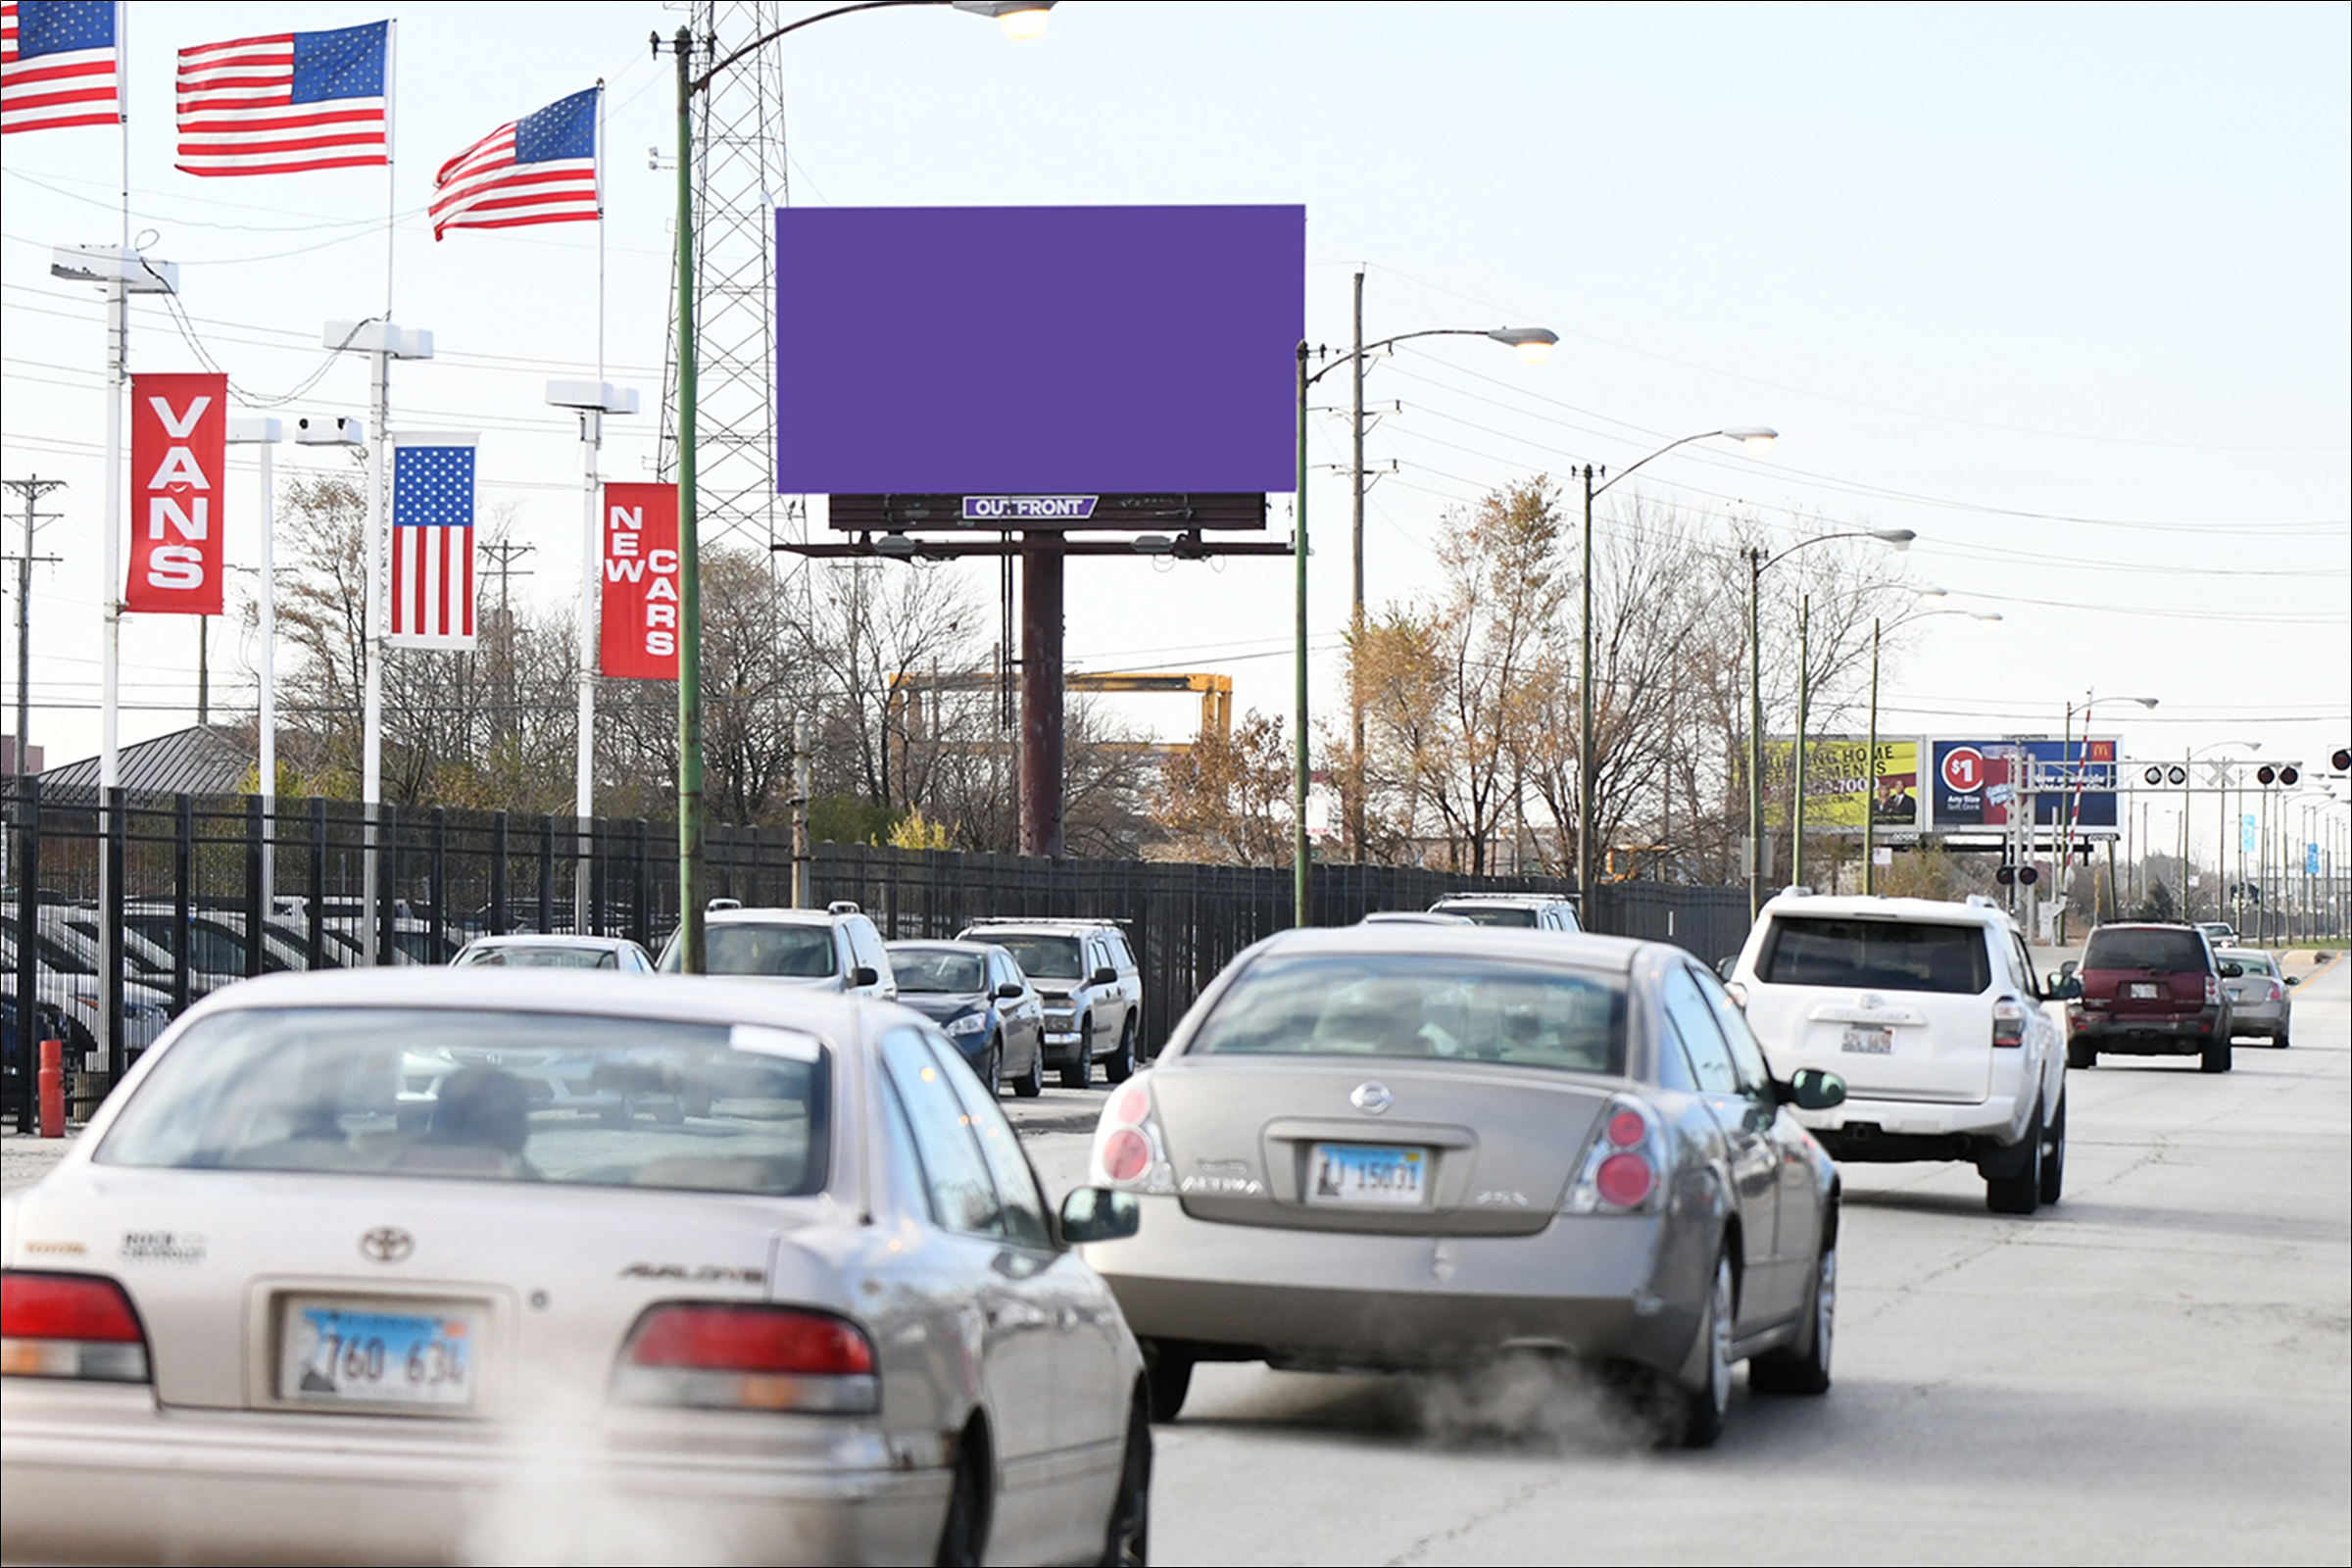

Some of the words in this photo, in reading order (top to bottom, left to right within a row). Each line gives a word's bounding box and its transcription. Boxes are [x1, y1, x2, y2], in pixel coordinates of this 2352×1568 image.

[147, 396, 212, 590] VANS
[605, 506, 646, 583] NEW
[645, 549, 678, 656] CARS
[1950, 759, 1974, 782] $1
[1947, 795, 1963, 804] Any
[323, 1333, 386, 1381] 760
